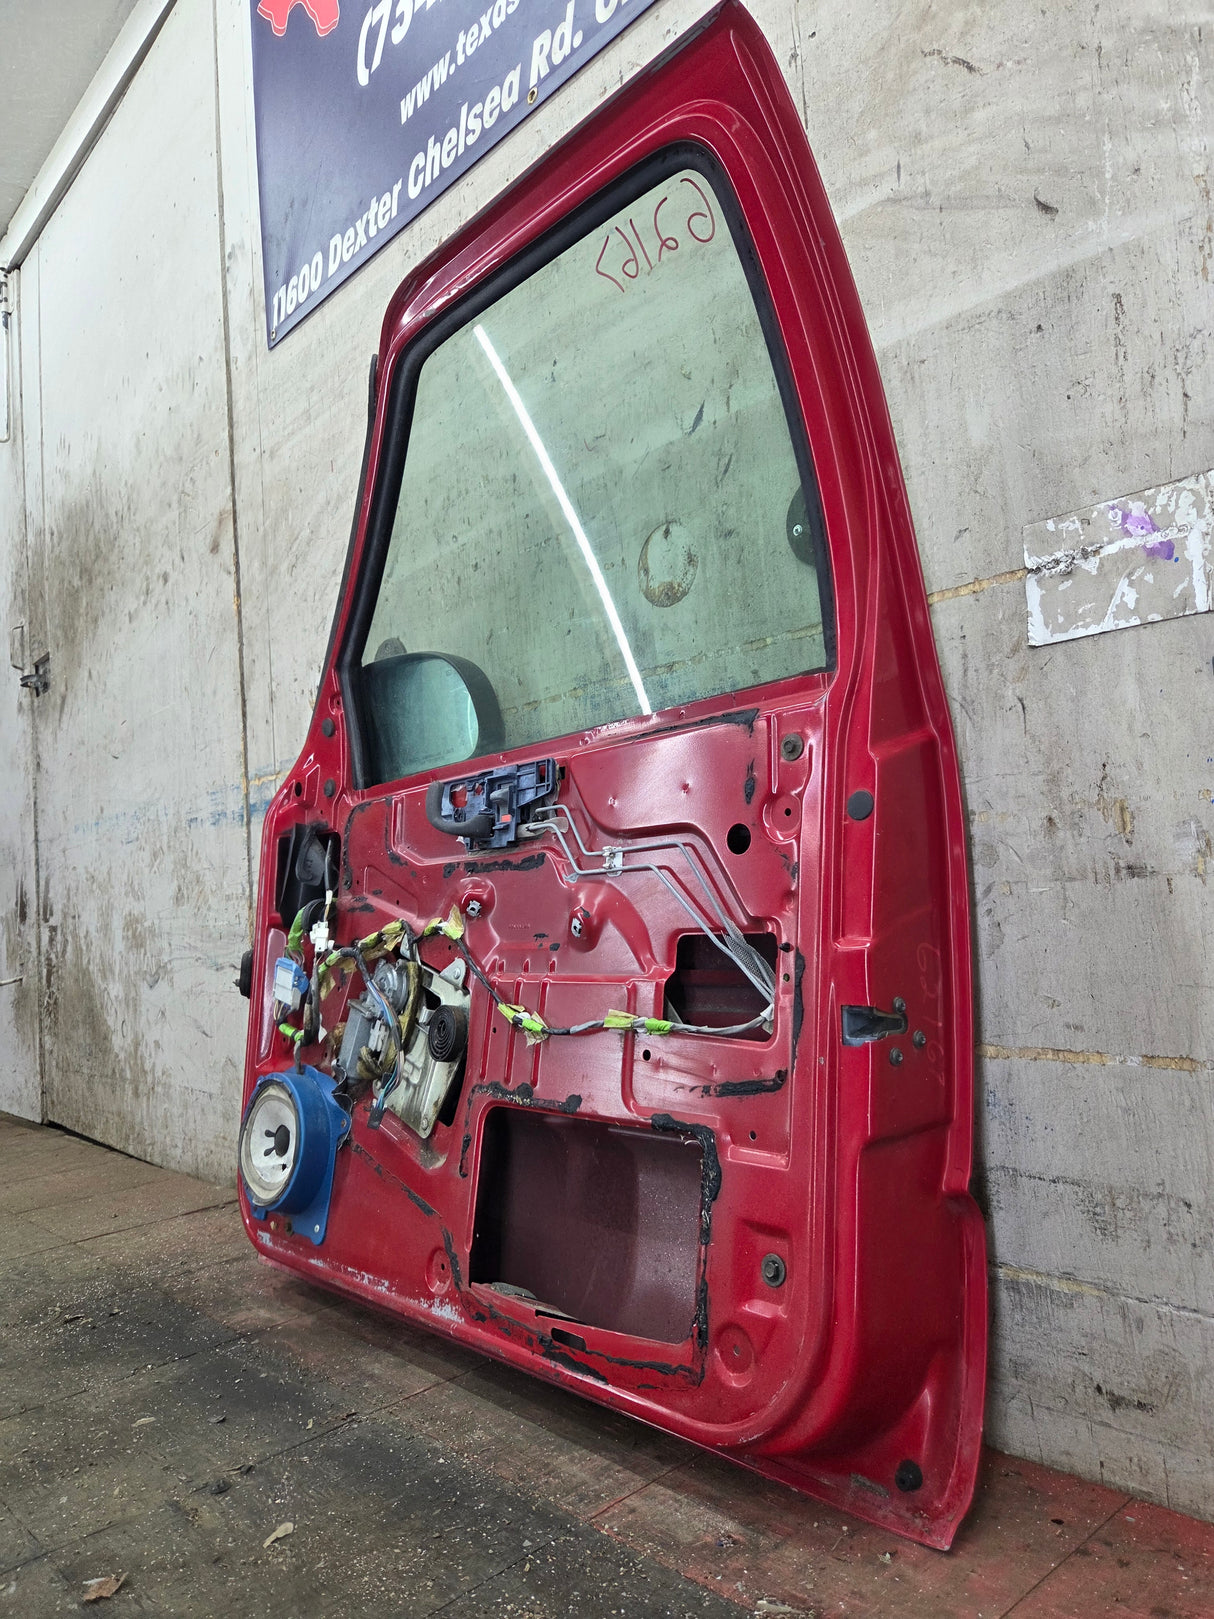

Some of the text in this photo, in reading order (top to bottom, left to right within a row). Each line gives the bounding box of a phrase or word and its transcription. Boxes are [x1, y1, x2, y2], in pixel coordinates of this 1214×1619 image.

[272, 1, 583, 330] 11600 Dexter Chelsea Rd.
